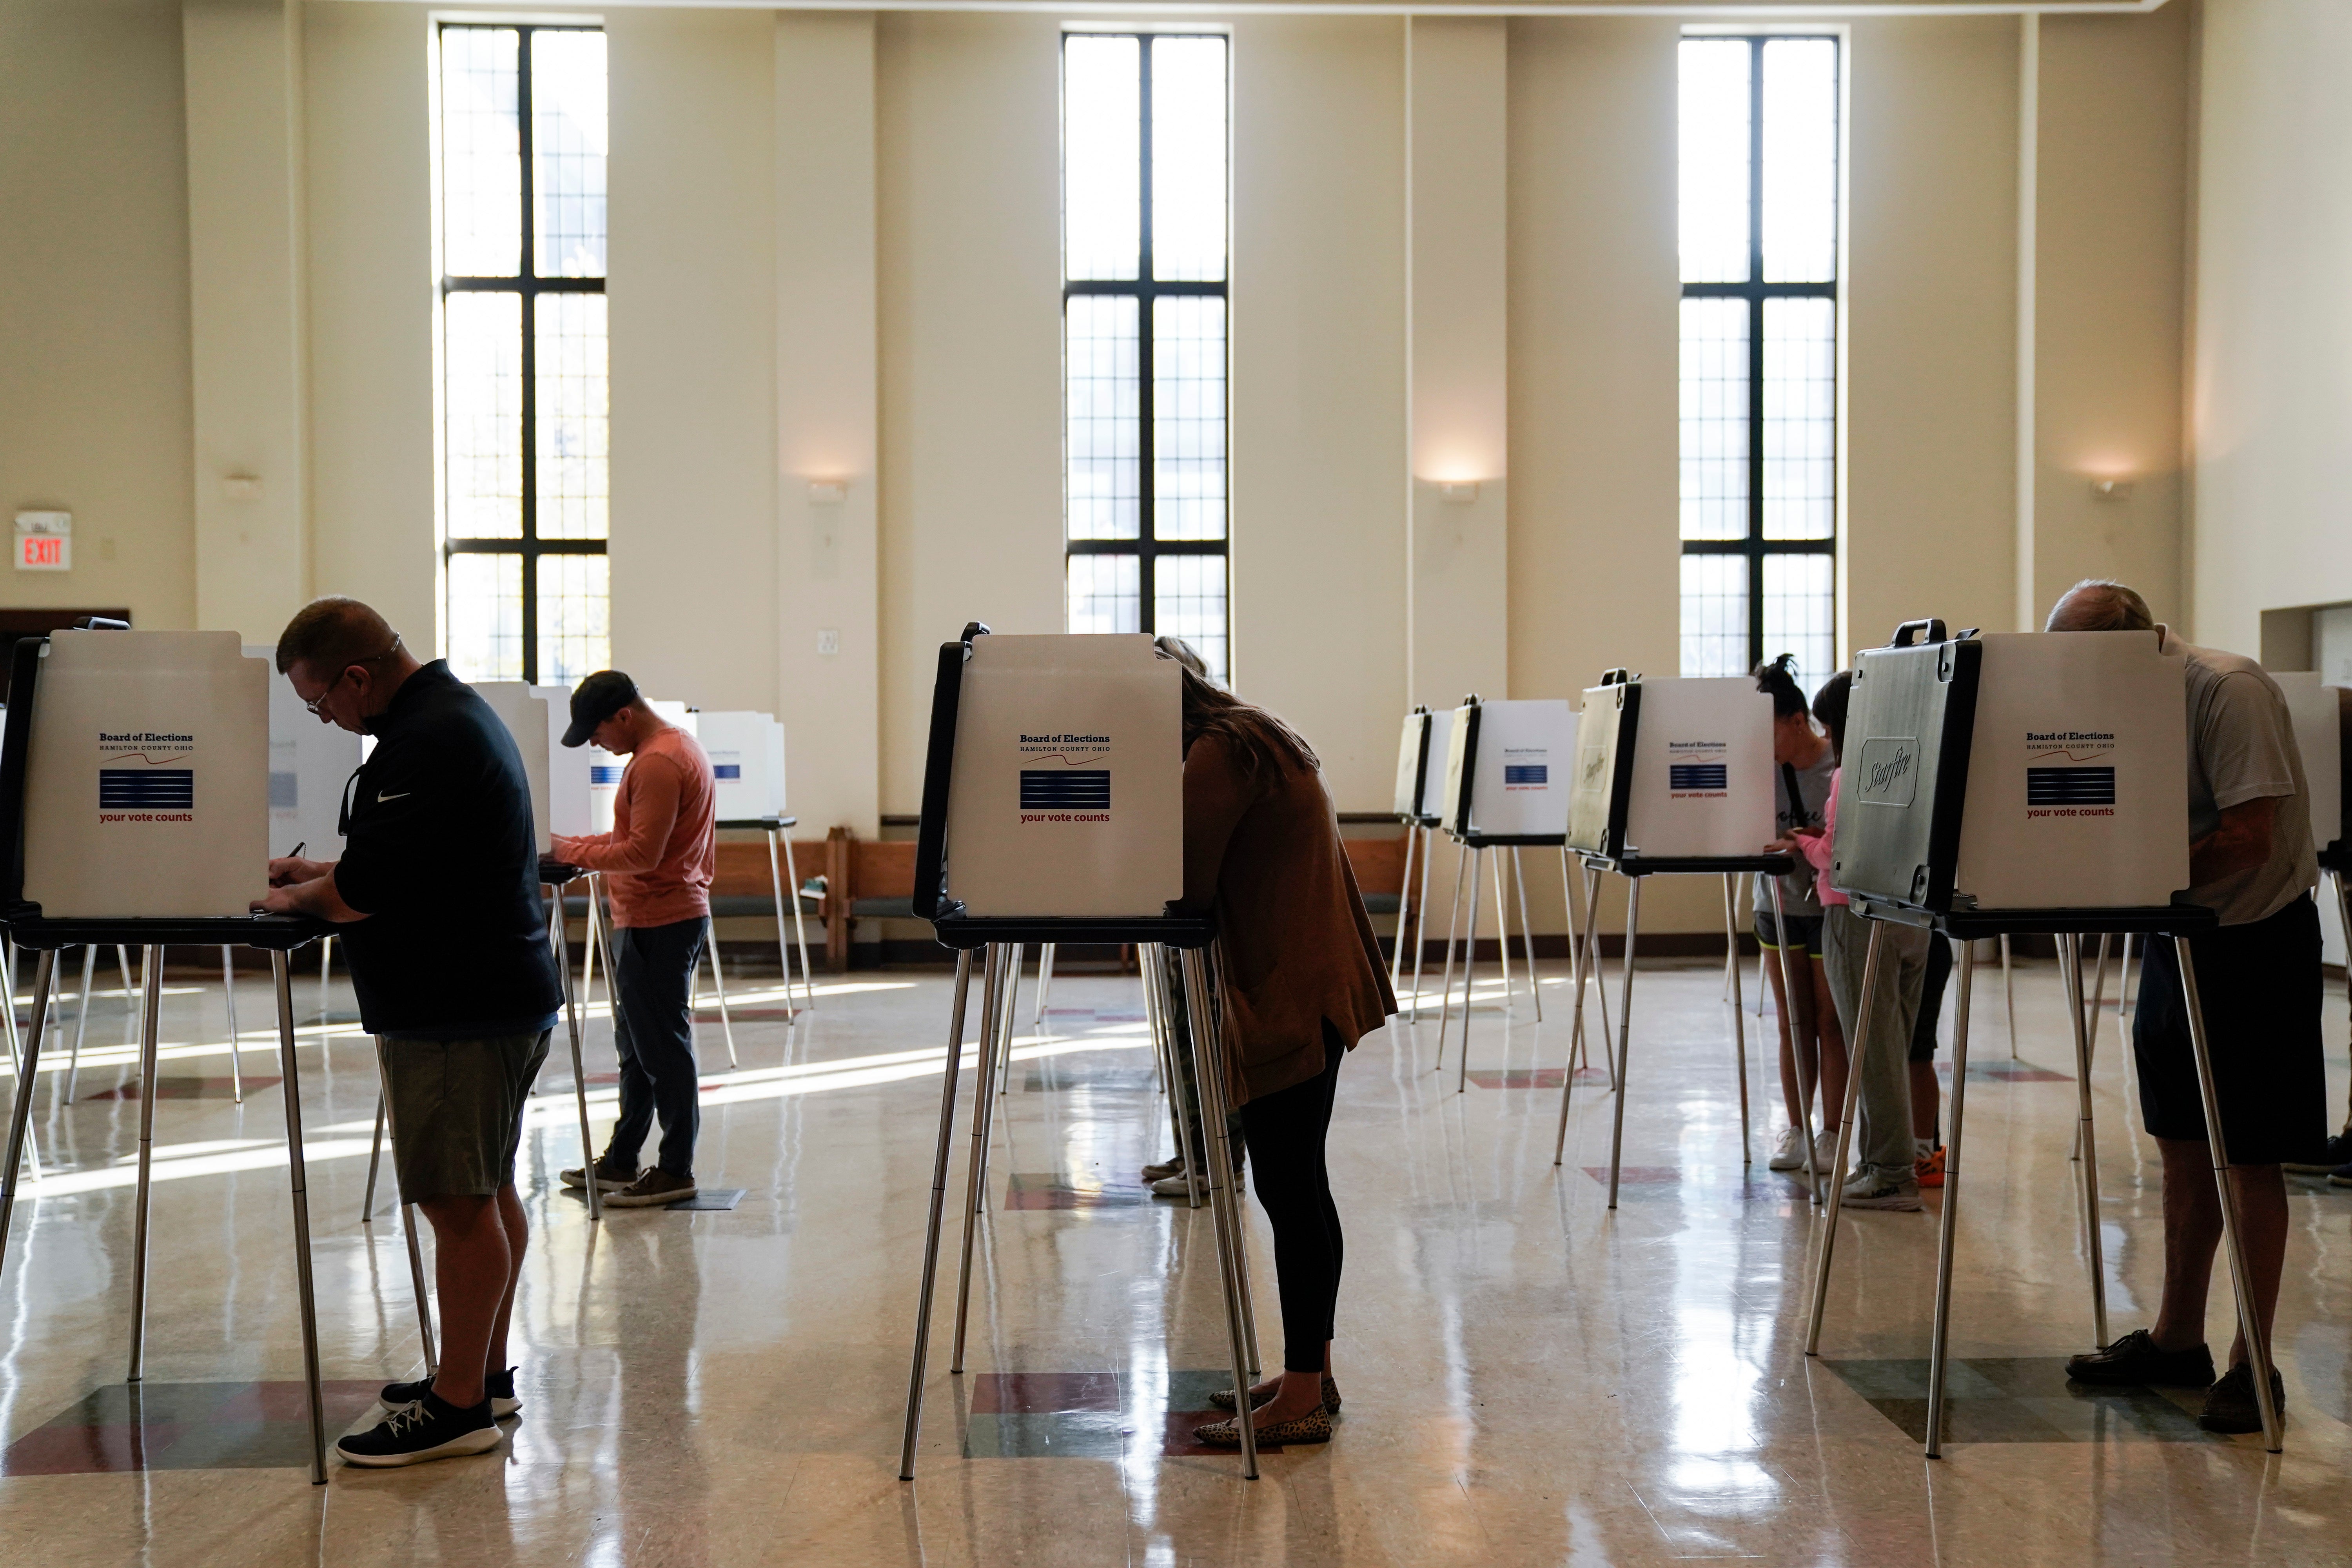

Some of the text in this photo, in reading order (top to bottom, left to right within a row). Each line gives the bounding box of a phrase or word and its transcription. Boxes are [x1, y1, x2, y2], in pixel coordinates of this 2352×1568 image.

[25, 538, 62, 564] EXIT
[1865, 746, 1911, 793] Starfire
[100, 814, 125, 824] your
[2027, 809, 2051, 819] your
[1021, 815, 1045, 824] your
